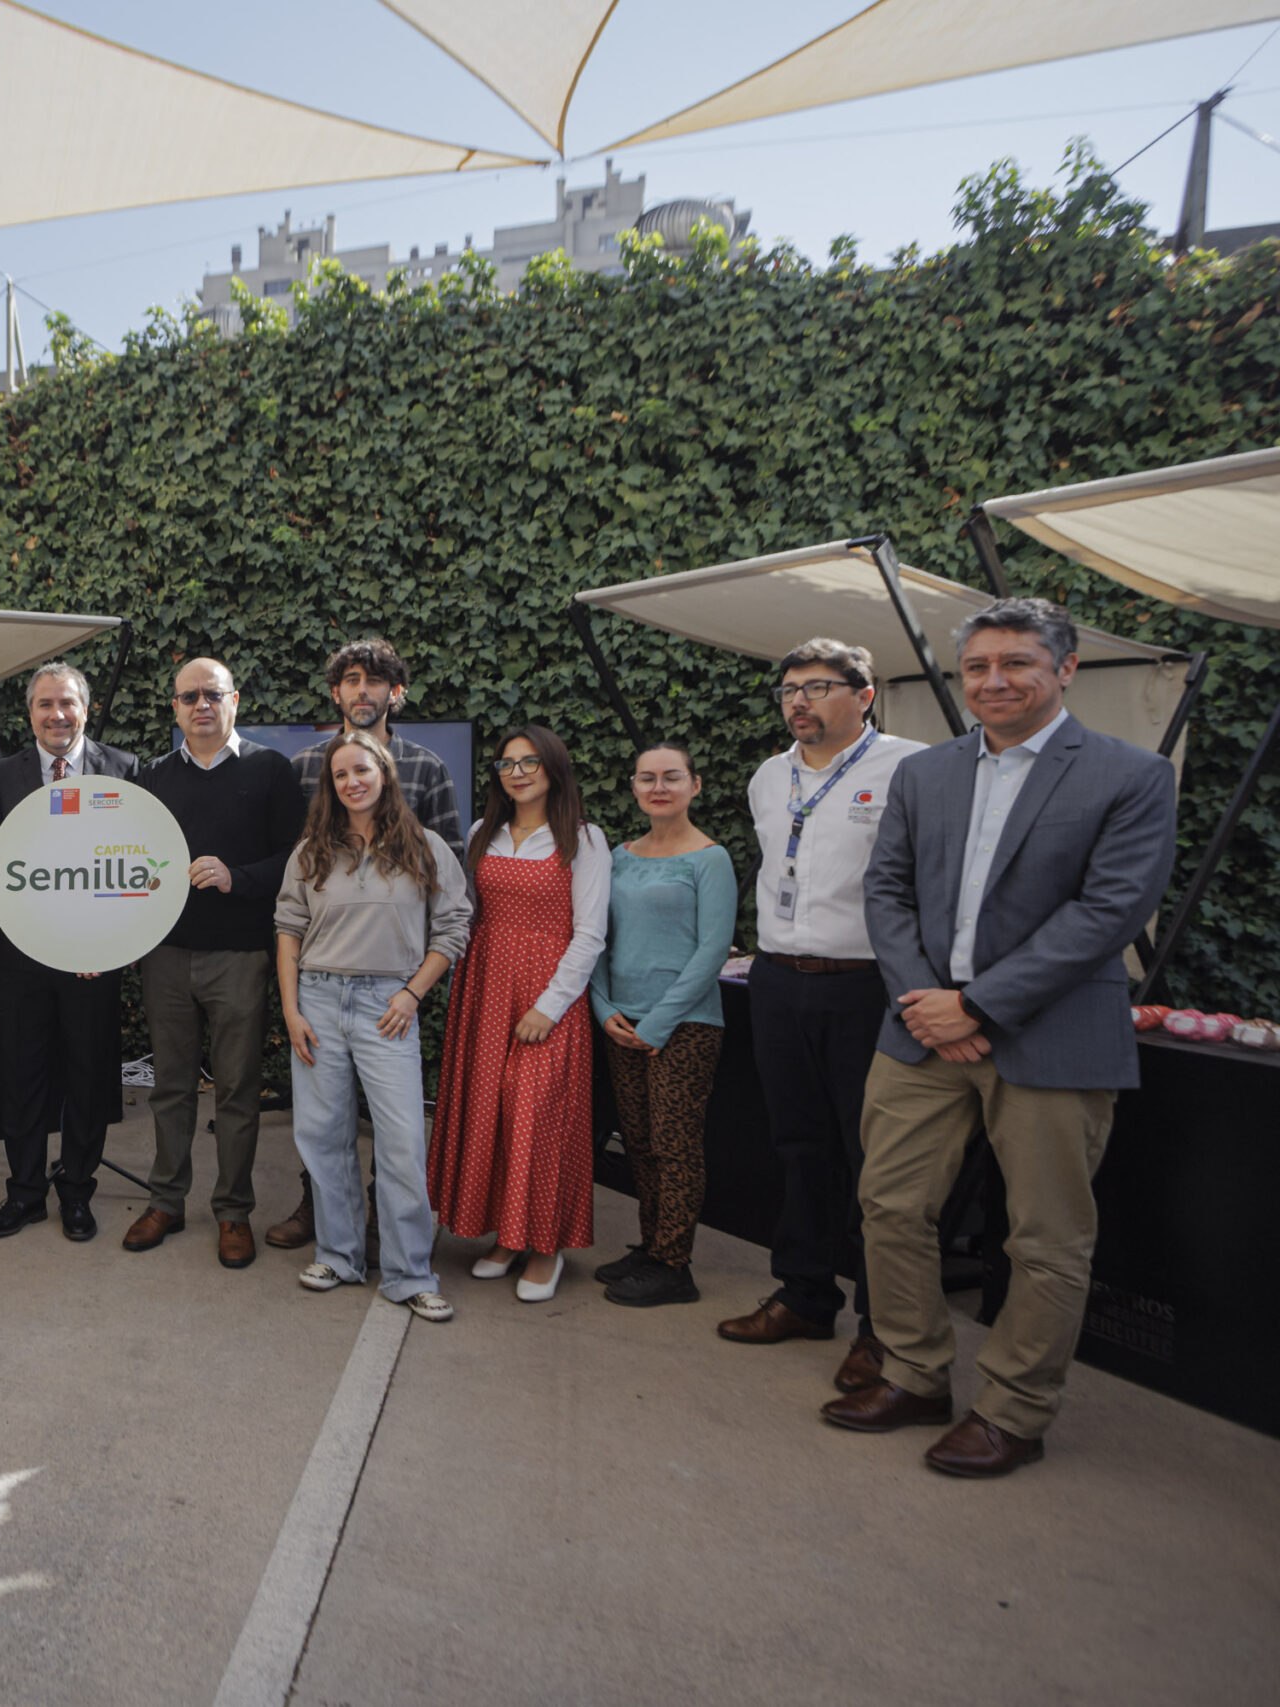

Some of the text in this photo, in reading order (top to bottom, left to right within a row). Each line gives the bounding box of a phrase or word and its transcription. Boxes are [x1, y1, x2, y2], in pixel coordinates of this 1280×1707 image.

[88, 798, 124, 806] SERCOTEC
[94, 845, 149, 856] CAPITAL
[6, 859, 149, 891] Semilla
